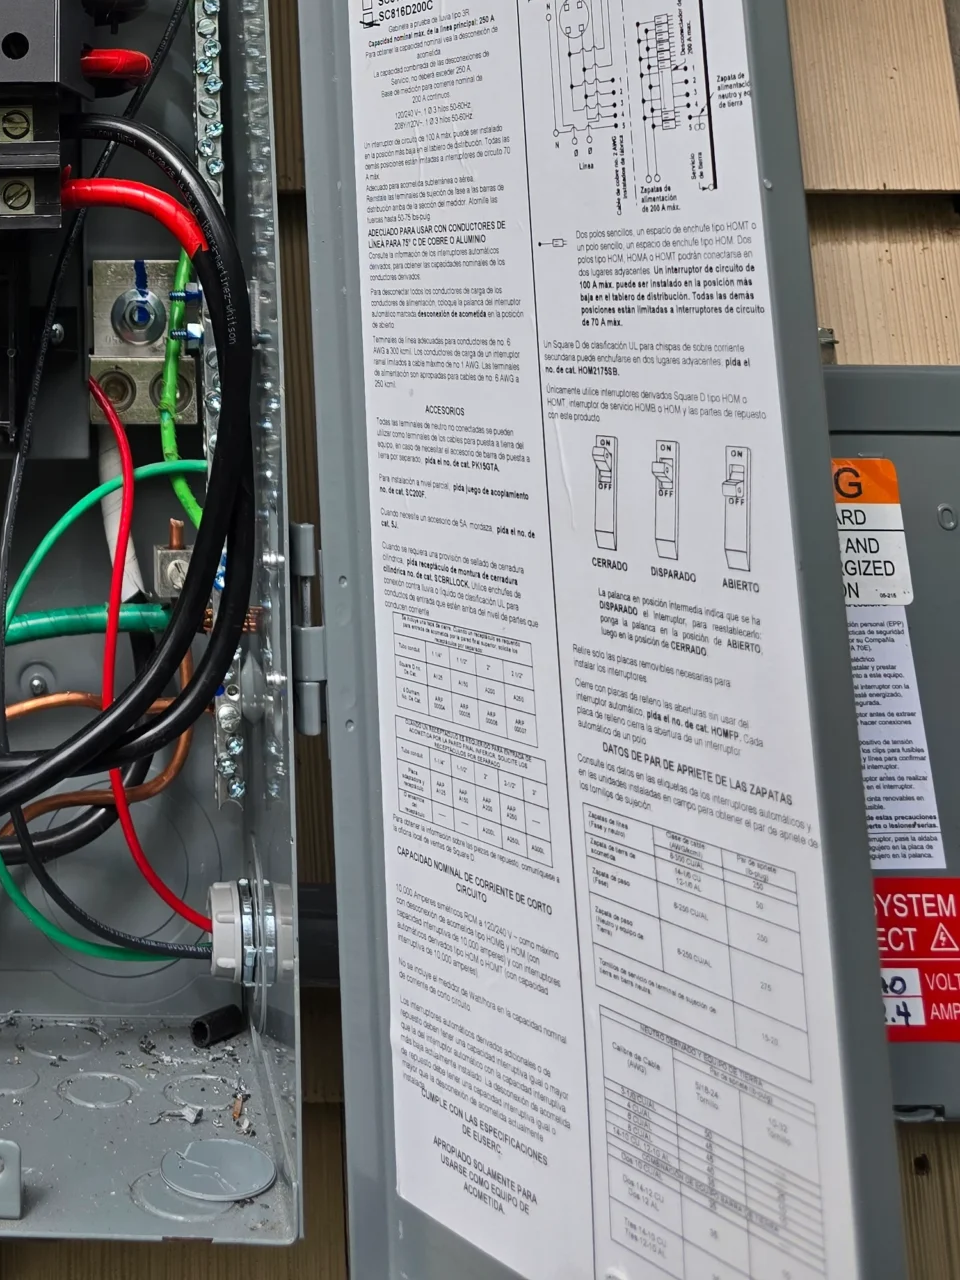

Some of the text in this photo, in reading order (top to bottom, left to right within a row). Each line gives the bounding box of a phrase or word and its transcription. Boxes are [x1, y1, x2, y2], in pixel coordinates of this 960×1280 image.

[379, 0, 433, 22] SC816D200C
[368, 221, 506, 236] ADECUADO PARA USAR CON CONDUCTORES DE
[425, 405, 465, 416] ACCESORIOS
[836, 509, 866, 526] RD
[846, 538, 879, 553] AND
[592, 557, 628, 571] CERRADO
[842, 560, 895, 576] GIZED
[651, 567, 696, 582] DISPARADO
[722, 578, 759, 593] ABIERTO
[602, 742, 793, 806] DATOS DE PAR DE APRIETE DE LAS ZAPATAS
[397, 846, 552, 915] CAPACIDAD NOMINAL DE CORRIENTE DE CORTO
[456, 883, 487, 902] CIRCUITO
[874, 894, 956, 917] YSTEM
[421, 1088, 548, 1165] CUMPLE CON LAS ESPECIFICACIONES
[462, 1124, 503, 1155] DE EUSERC.
[433, 1136, 537, 1205] APROPIADO SOLAMENTE PARA
[440, 1153, 530, 1215] USARSE COMO EQUIPO DE
[463, 1182, 505, 1215] ACOMETIDA.
